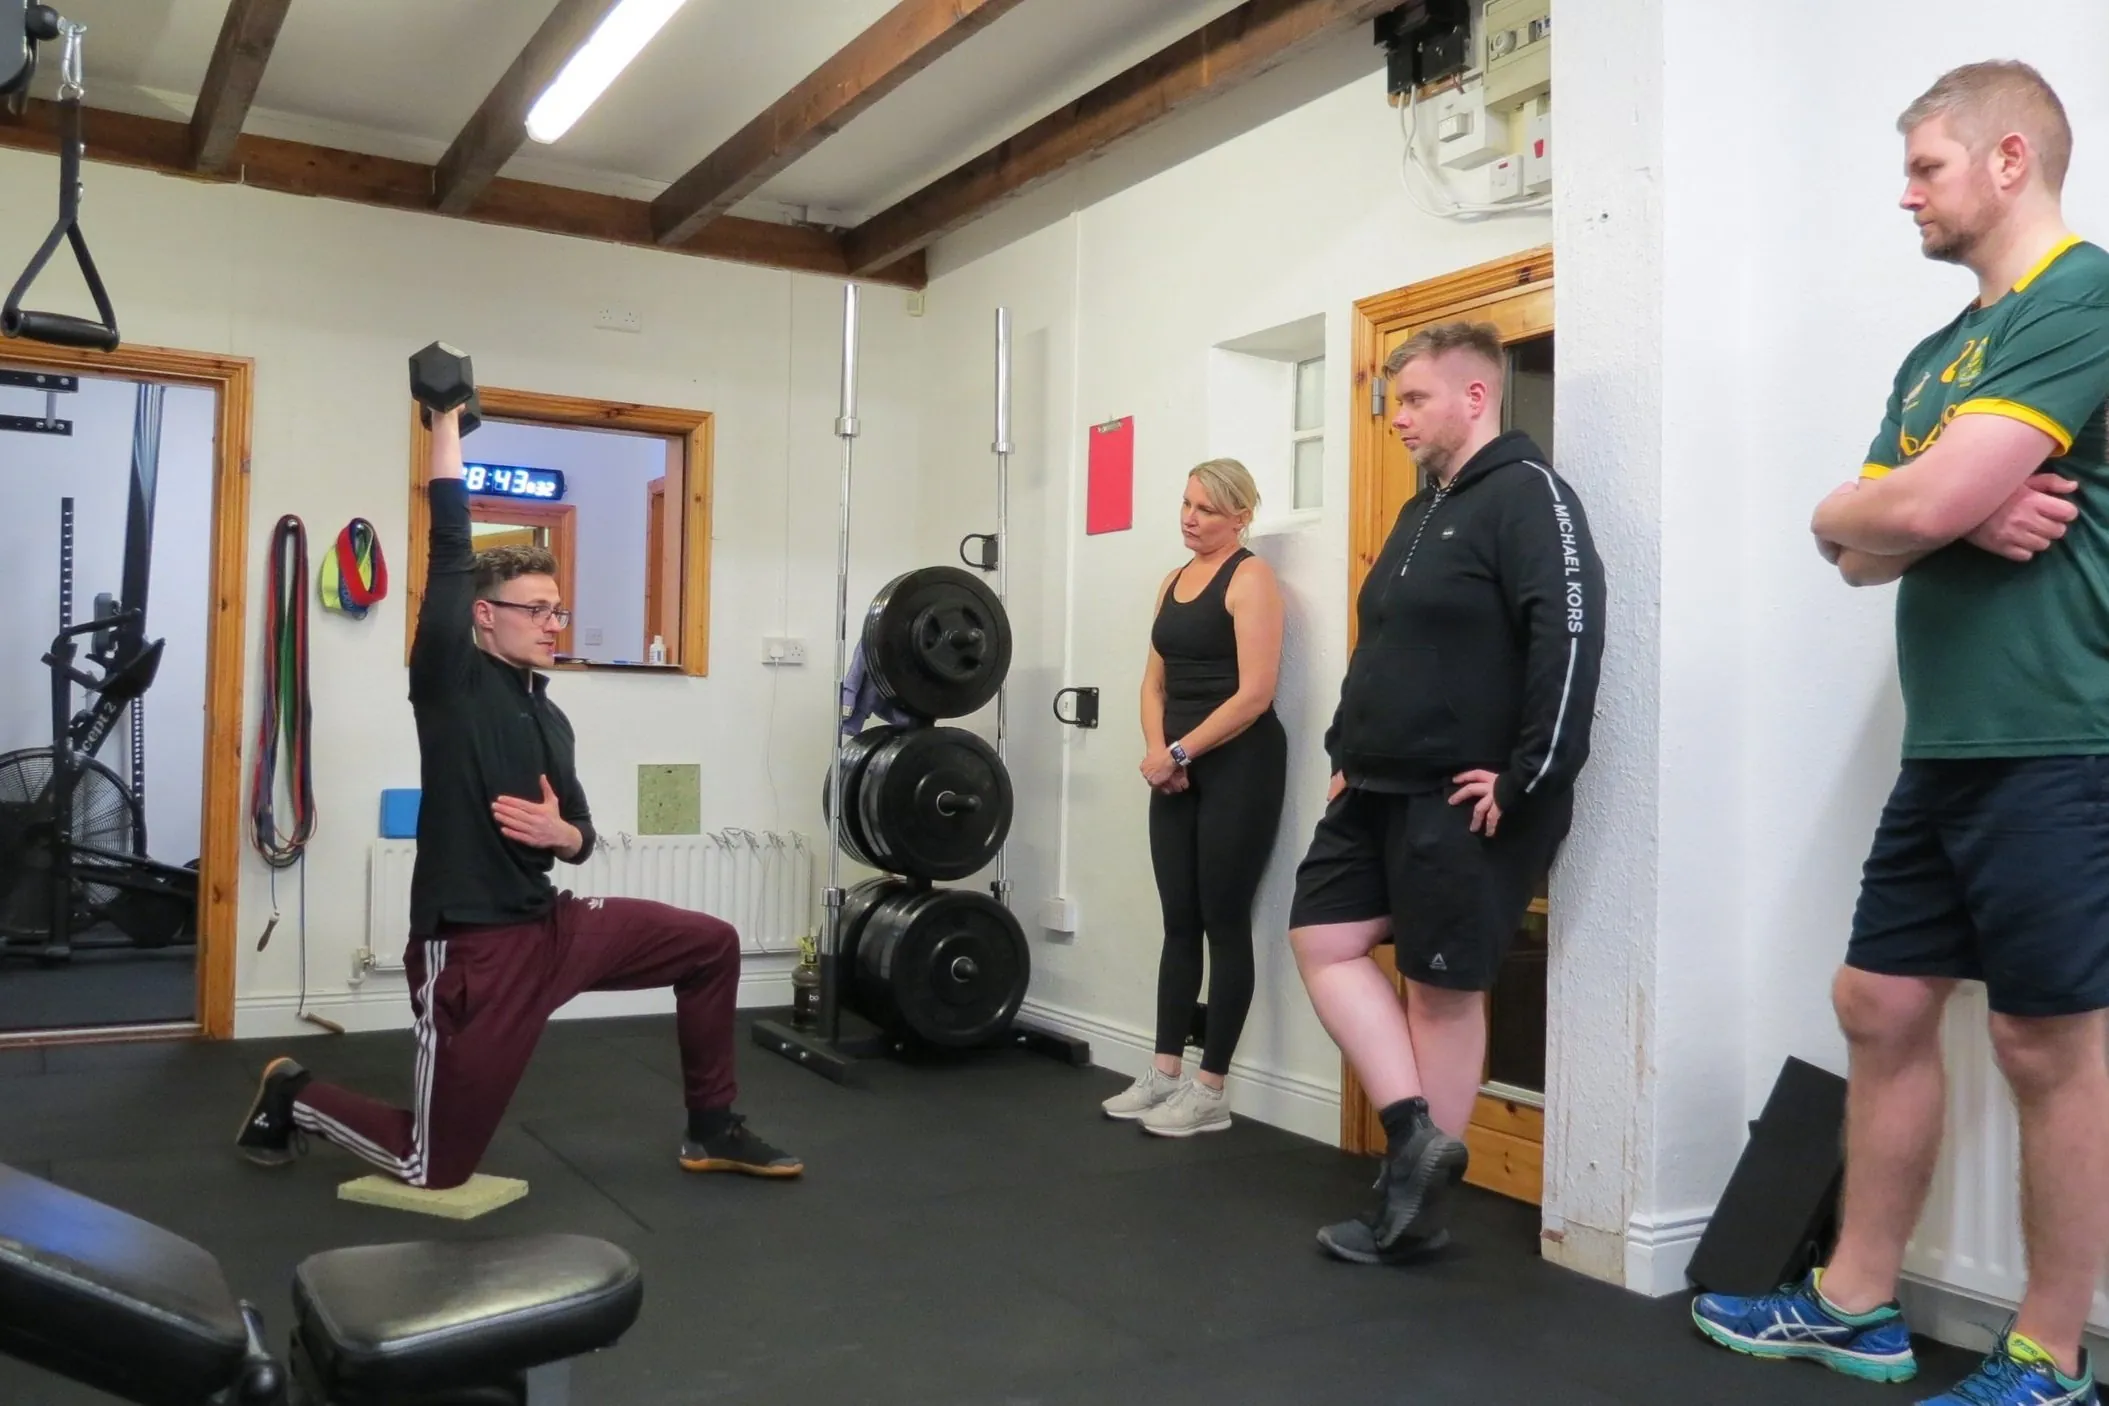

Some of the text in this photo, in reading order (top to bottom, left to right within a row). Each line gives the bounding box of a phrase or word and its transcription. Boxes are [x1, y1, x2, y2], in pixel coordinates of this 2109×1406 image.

[1553, 504, 1583, 632] MICHAEL KORS
[103, 701, 117, 714] 2
